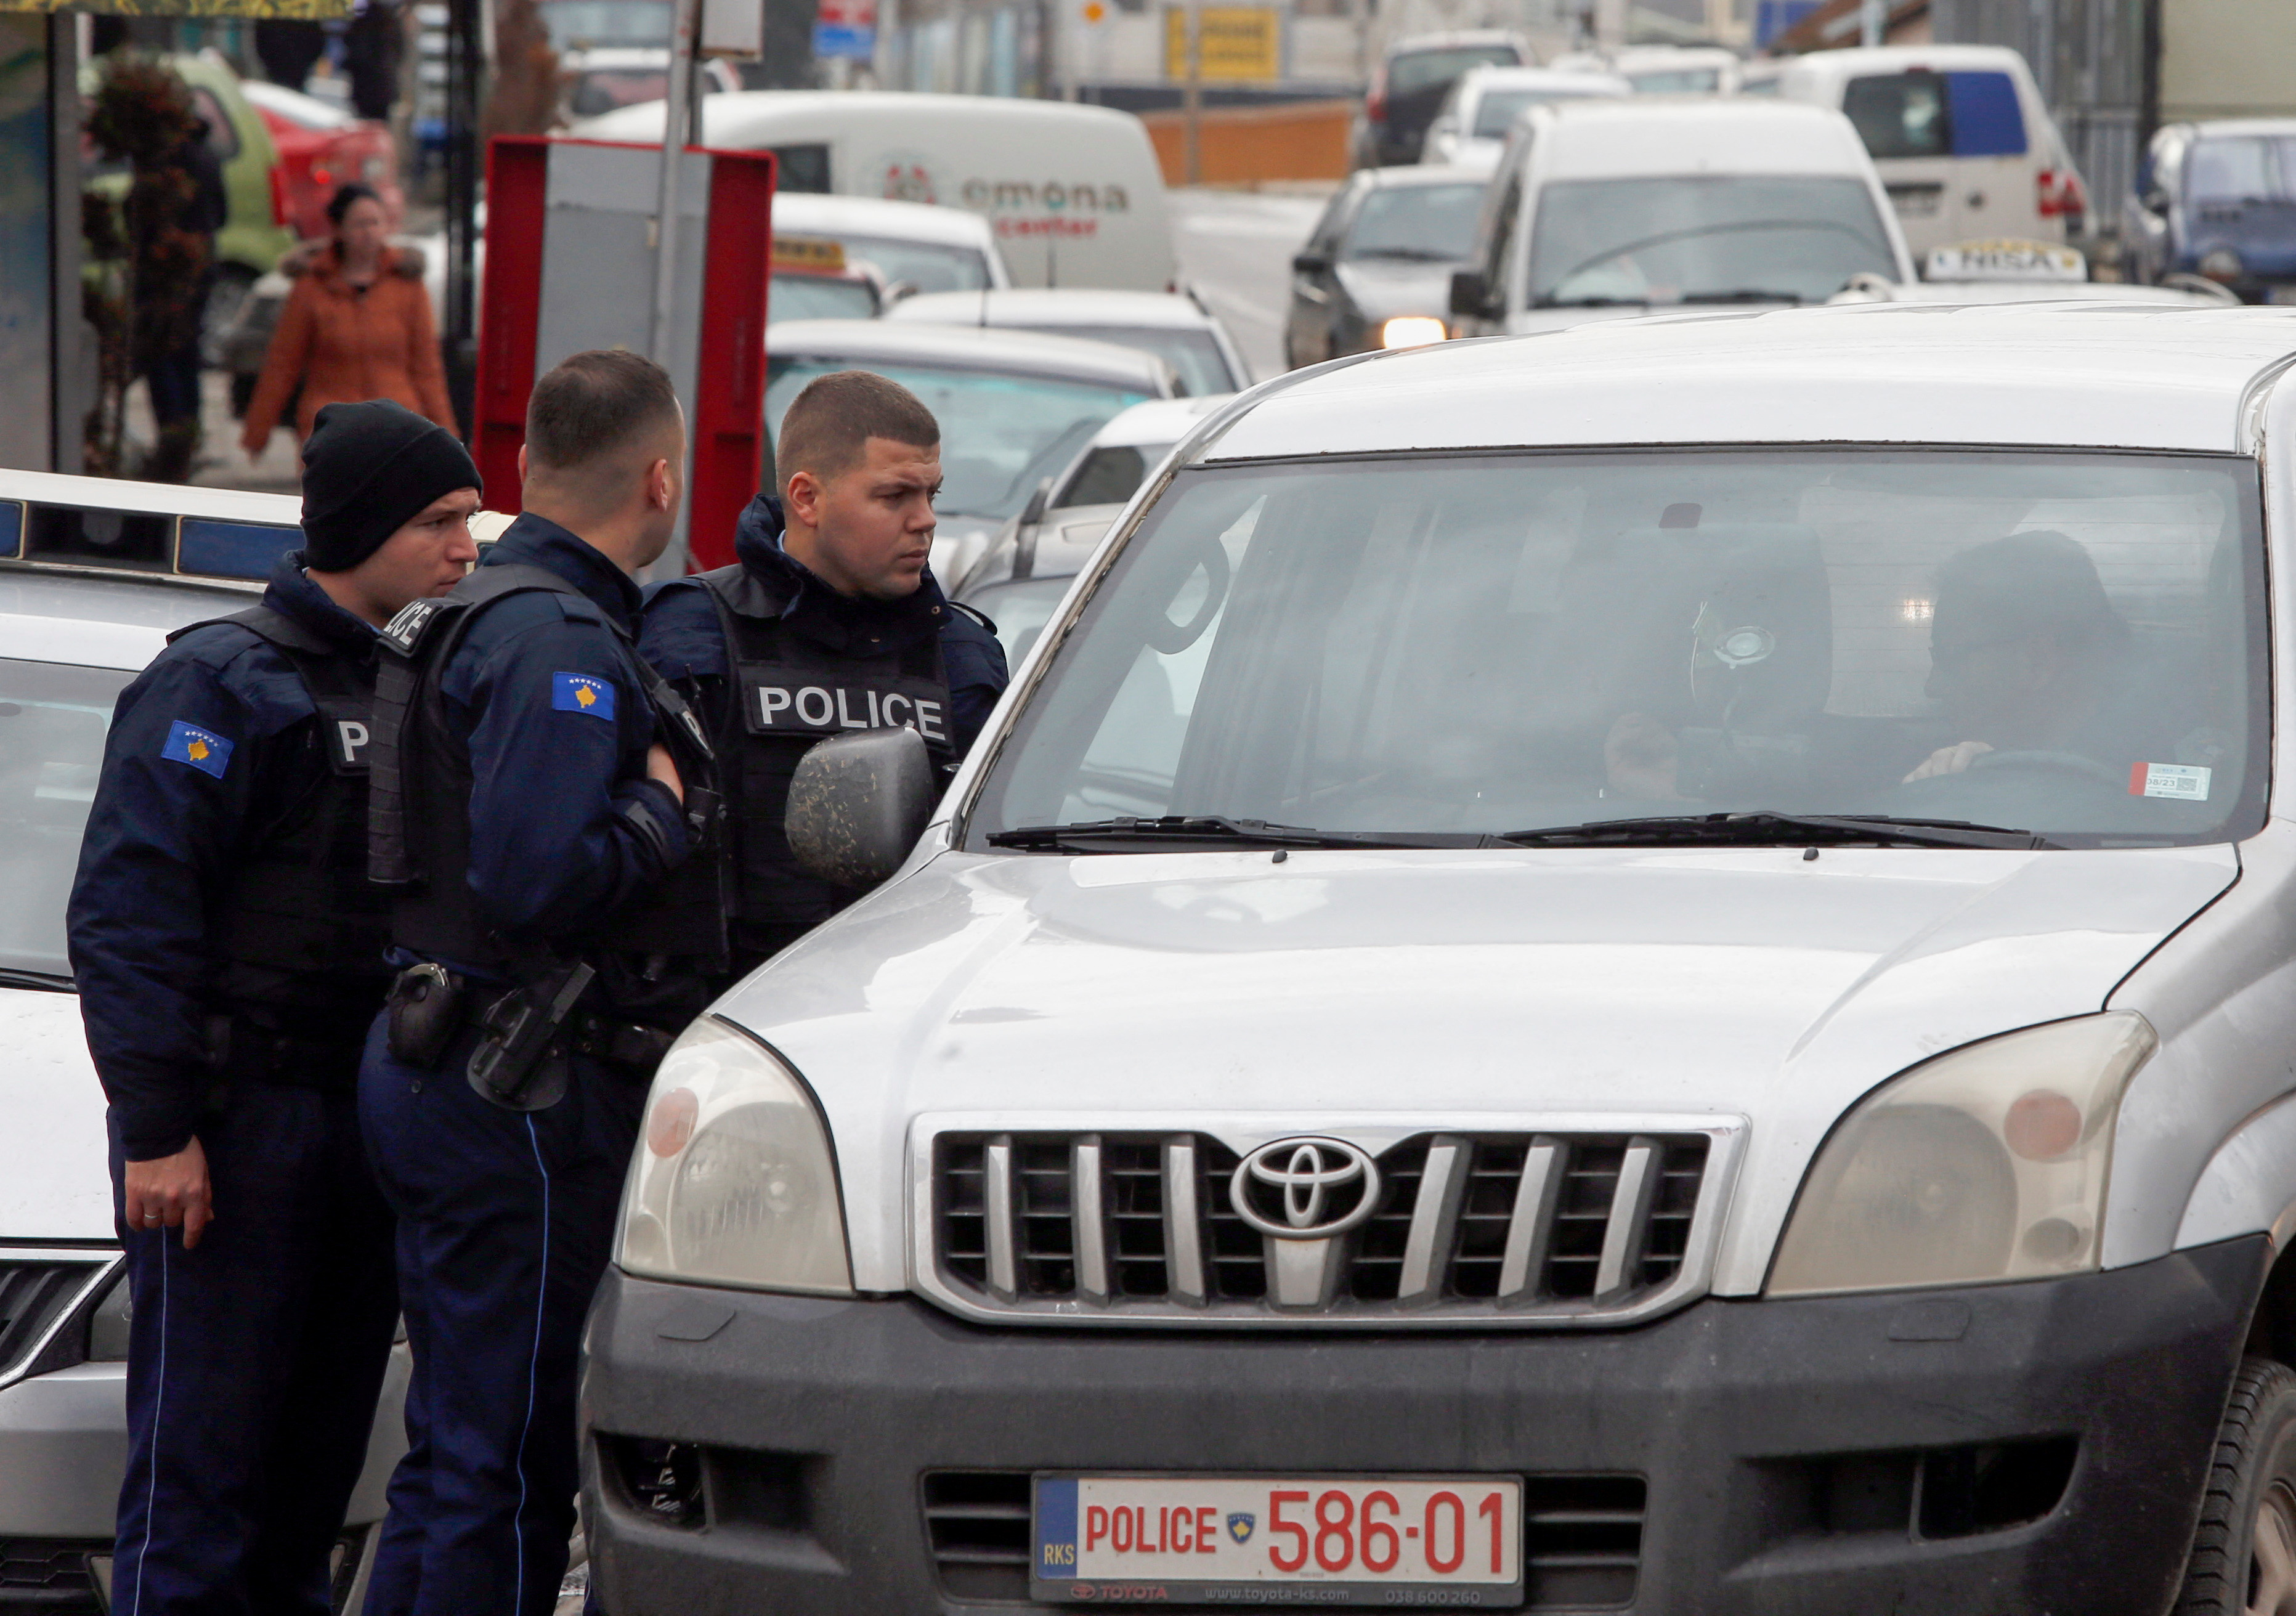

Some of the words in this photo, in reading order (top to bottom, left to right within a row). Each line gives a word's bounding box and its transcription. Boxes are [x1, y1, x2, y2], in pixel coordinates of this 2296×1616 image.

[758, 686, 946, 741] POLICE
[1086, 1505, 1217, 1554] POLICE
[1268, 1490, 1502, 1573] 586-01
[1044, 1544, 1075, 1565] RKS
[1101, 1586, 1169, 1600] TOYOTA
[1204, 1586, 1350, 1603] www.toyota-ks.com
[1385, 1589, 1414, 1604] 038
[1418, 1590, 1448, 1604] 600
